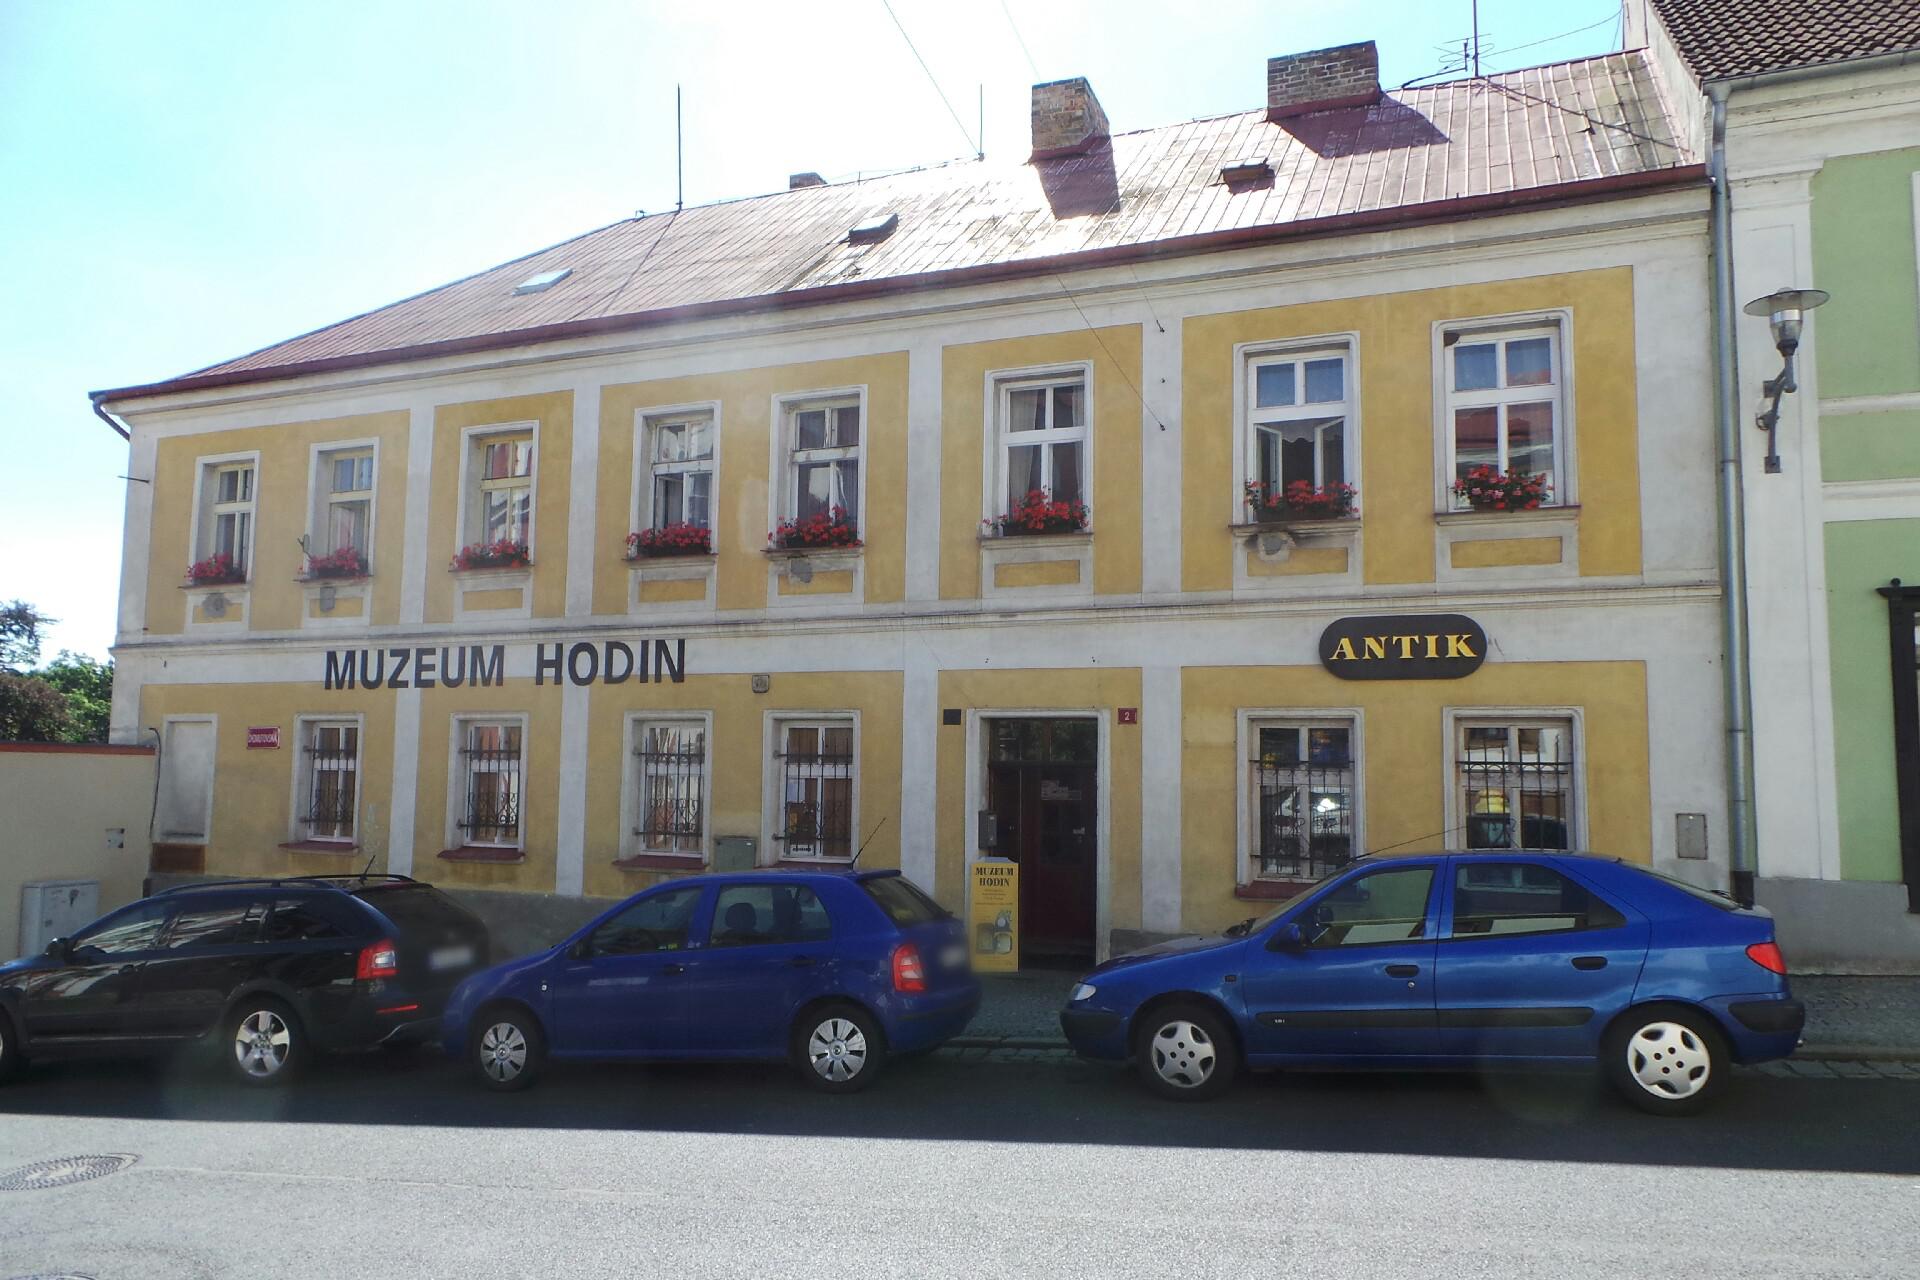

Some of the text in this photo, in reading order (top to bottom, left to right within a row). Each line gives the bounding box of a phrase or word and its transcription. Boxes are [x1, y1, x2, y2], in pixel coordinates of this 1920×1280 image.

[1329, 635, 1478, 660] ANTIK
[325, 639, 685, 689] MUZEUM HODIN
[1124, 711, 1130, 721] 2
[975, 867, 1014, 876] MUZEUM
[979, 877, 1010, 887] HODIN
